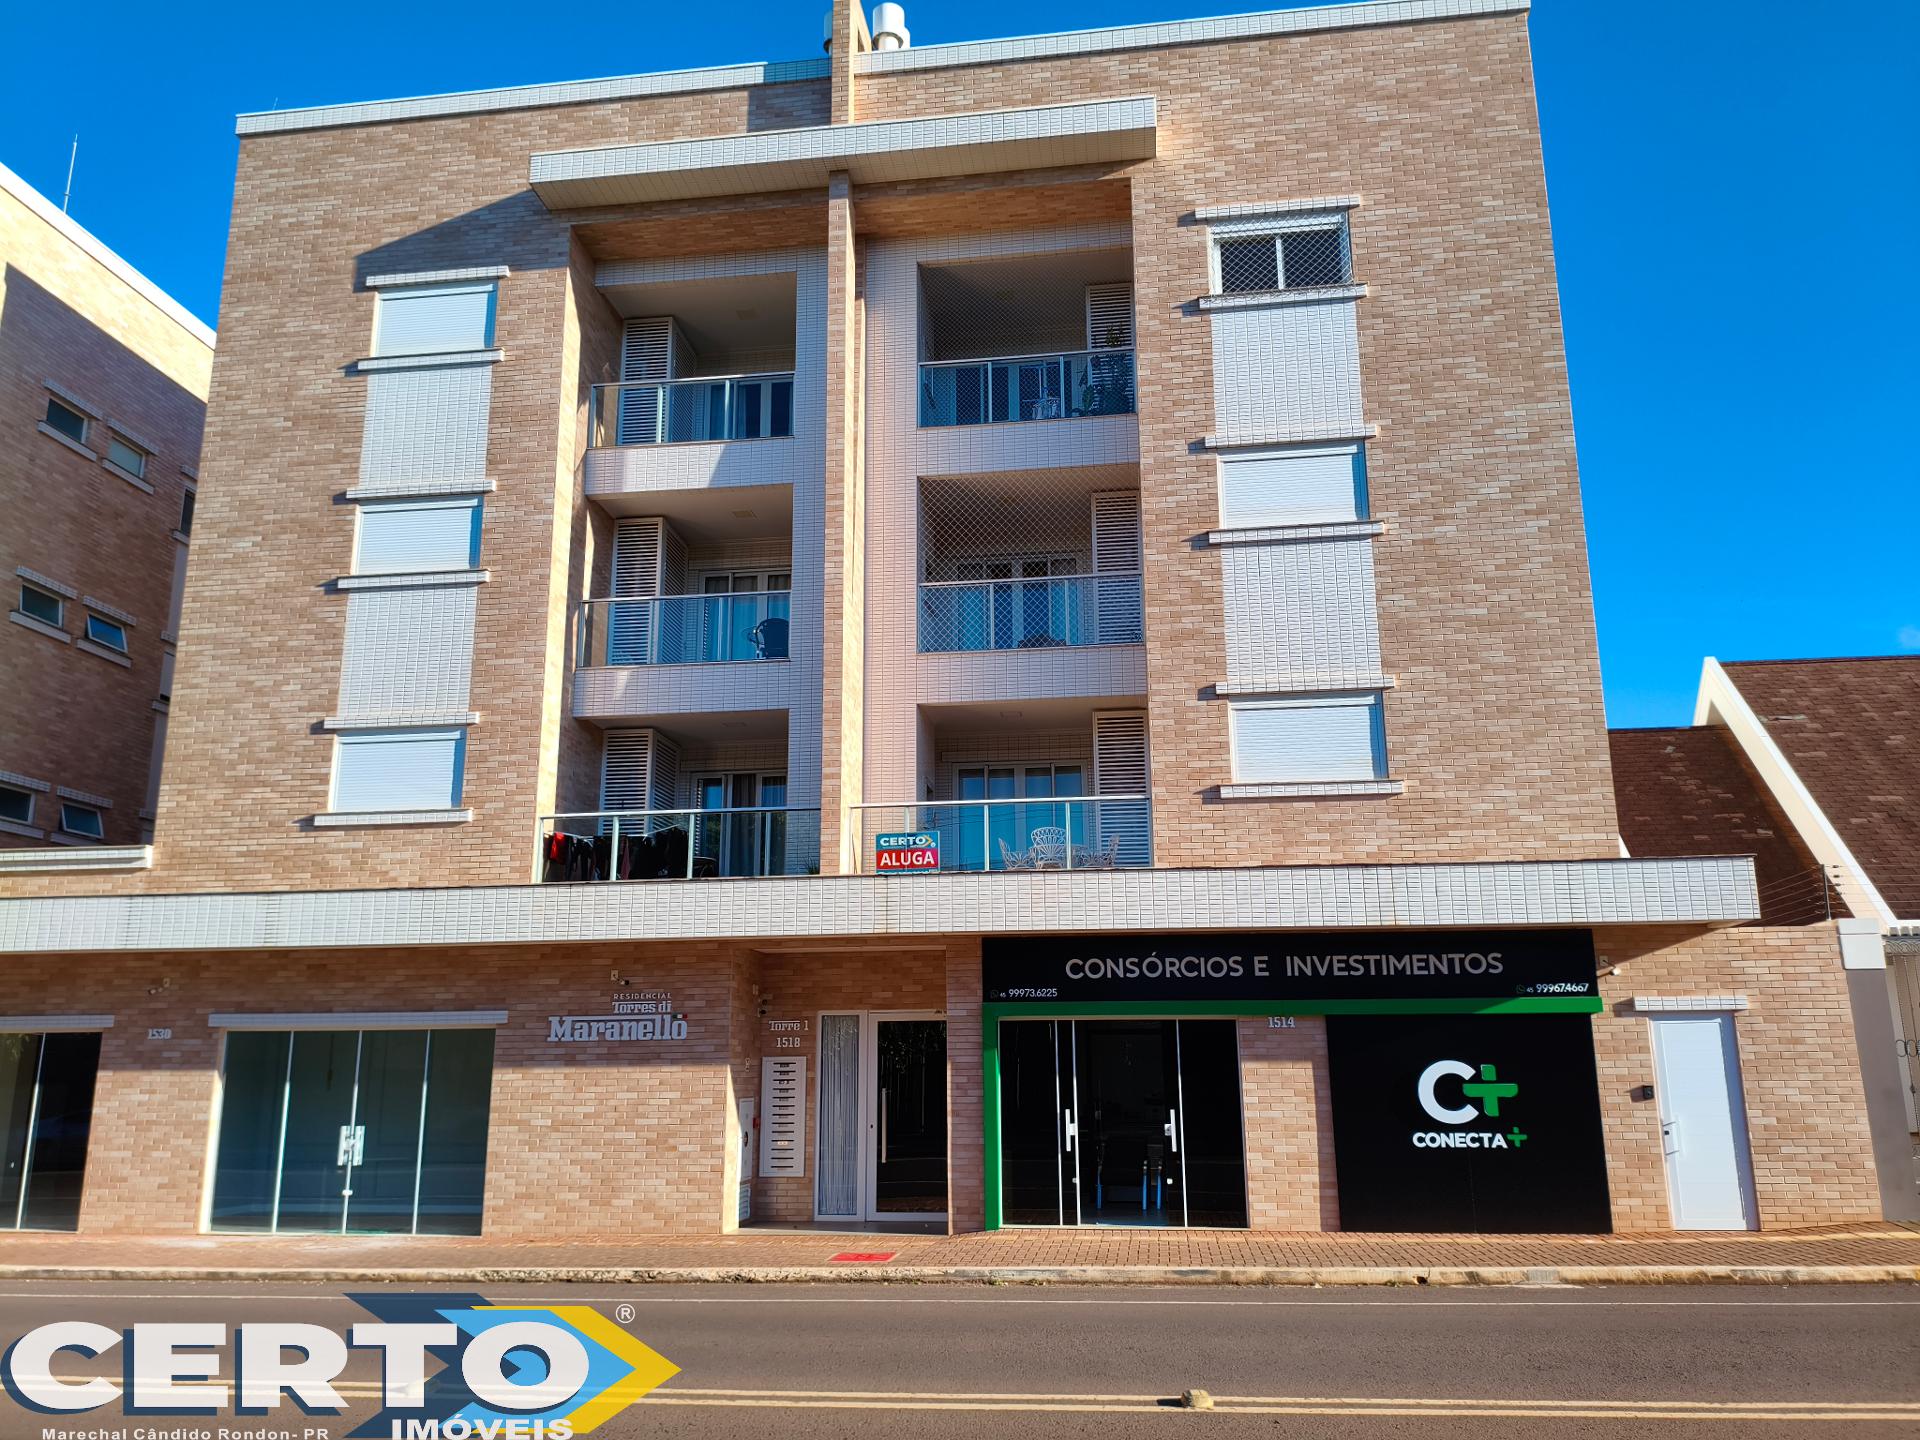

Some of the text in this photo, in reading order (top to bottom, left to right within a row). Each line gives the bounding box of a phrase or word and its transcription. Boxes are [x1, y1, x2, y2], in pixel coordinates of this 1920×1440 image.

[880, 836, 926, 846] CERTO
[880, 851, 935, 866] ALUGA
[1065, 952, 1504, 980] CONSÓRCIOS E INVESTIMENTOS
[613, 992, 672, 1000] RESIDENCIAL
[1008, 988, 1058, 998] 99973.6225
[611, 1000, 672, 1014] Torres di
[547, 1014, 688, 1042] Maranello
[768, 1020, 801, 1031] Torre
[1267, 1016, 1296, 1028] 1514
[147, 1028, 172, 1040] 1530
[776, 1037, 801, 1048] 1518
